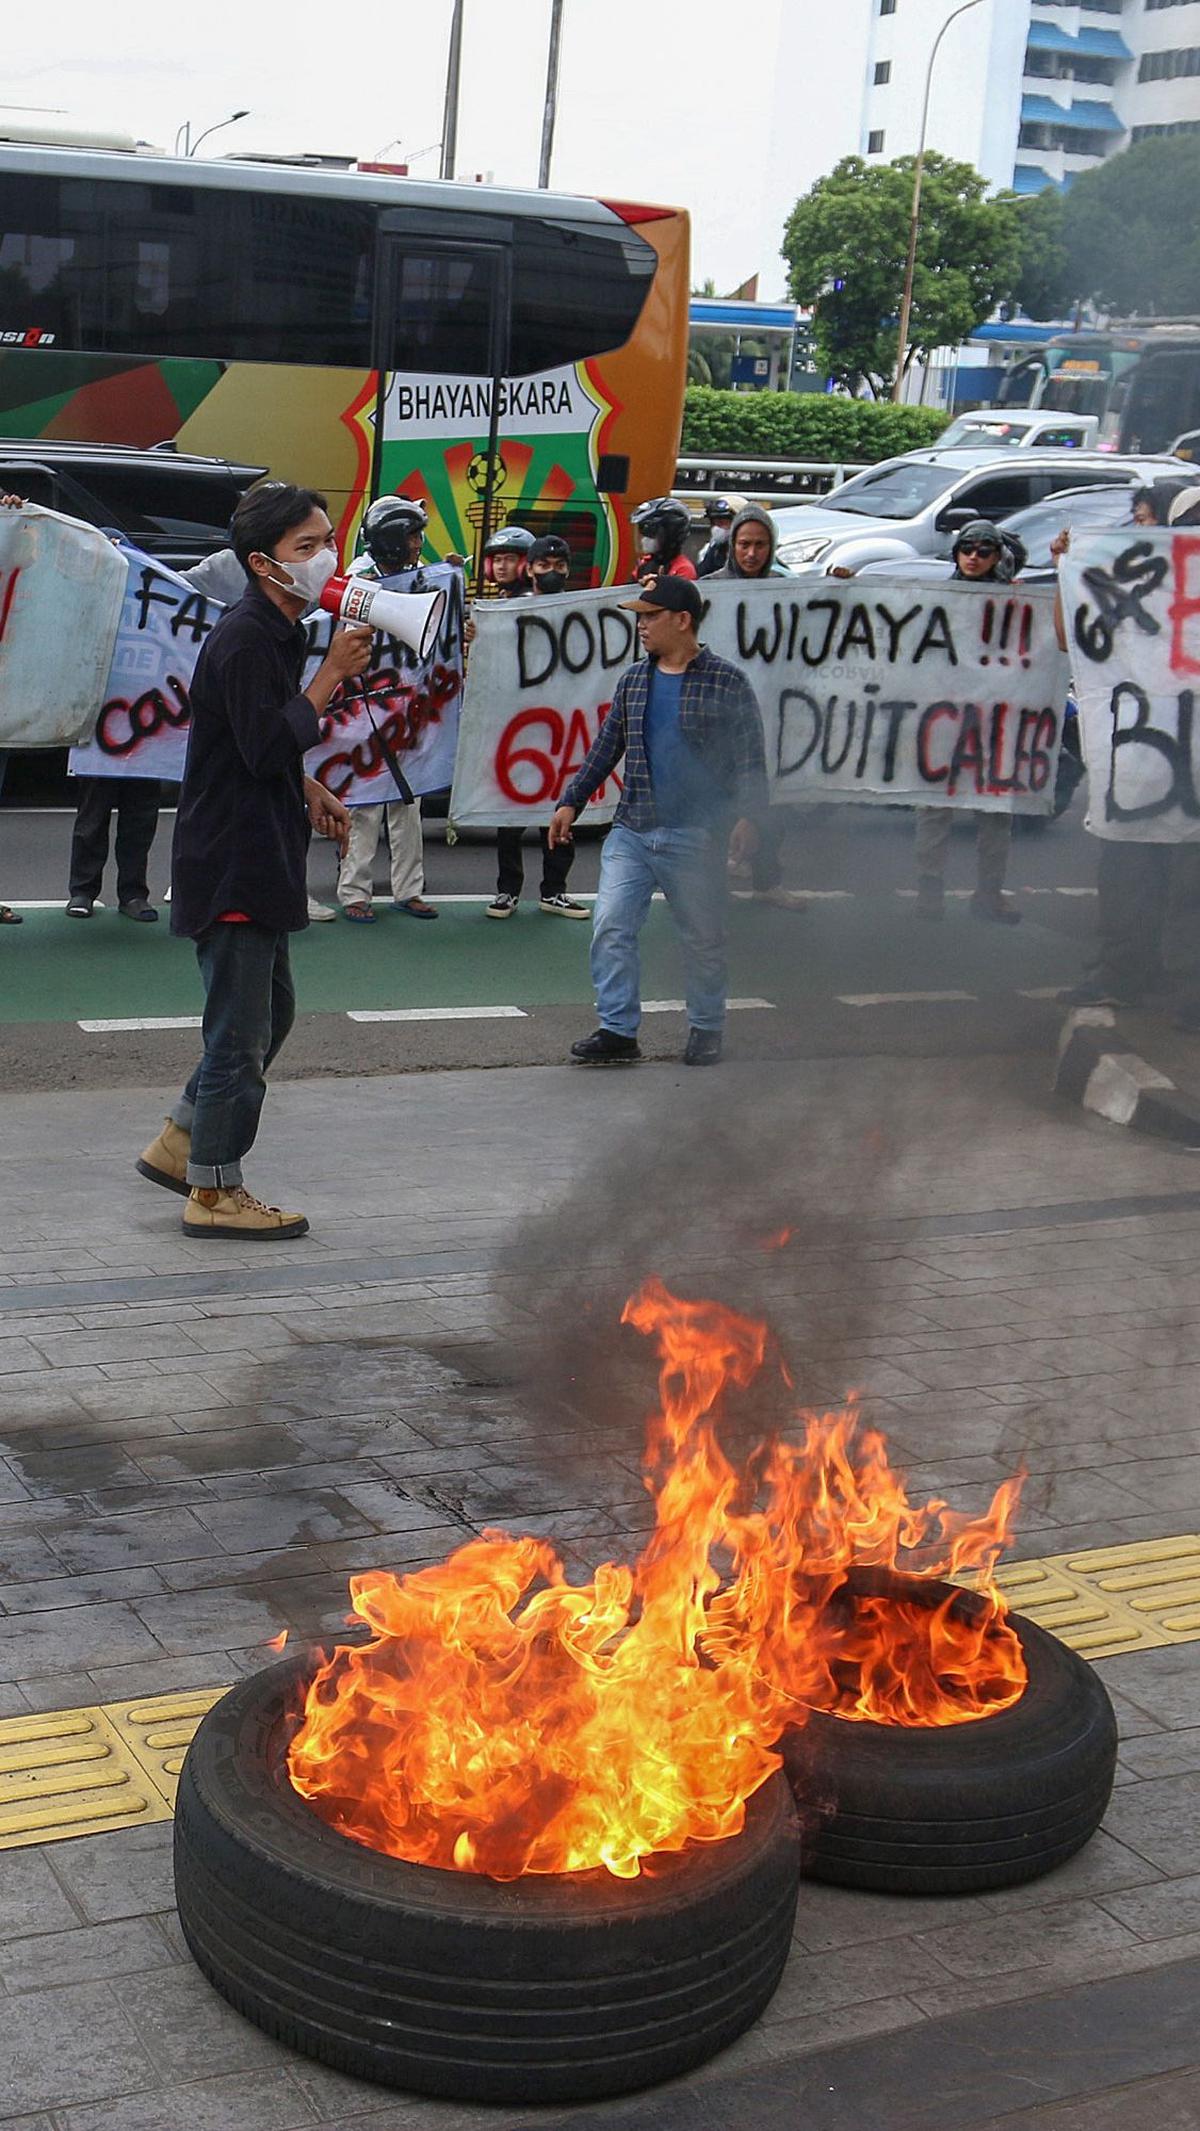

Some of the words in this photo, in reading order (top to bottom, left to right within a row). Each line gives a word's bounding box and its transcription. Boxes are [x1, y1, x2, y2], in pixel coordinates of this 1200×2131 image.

[399, 380, 573, 421] BHAYANGKARA
[134, 567, 224, 642] FA
[516, 599, 711, 689] DOD
[737, 600, 958, 667] WIJAYA
